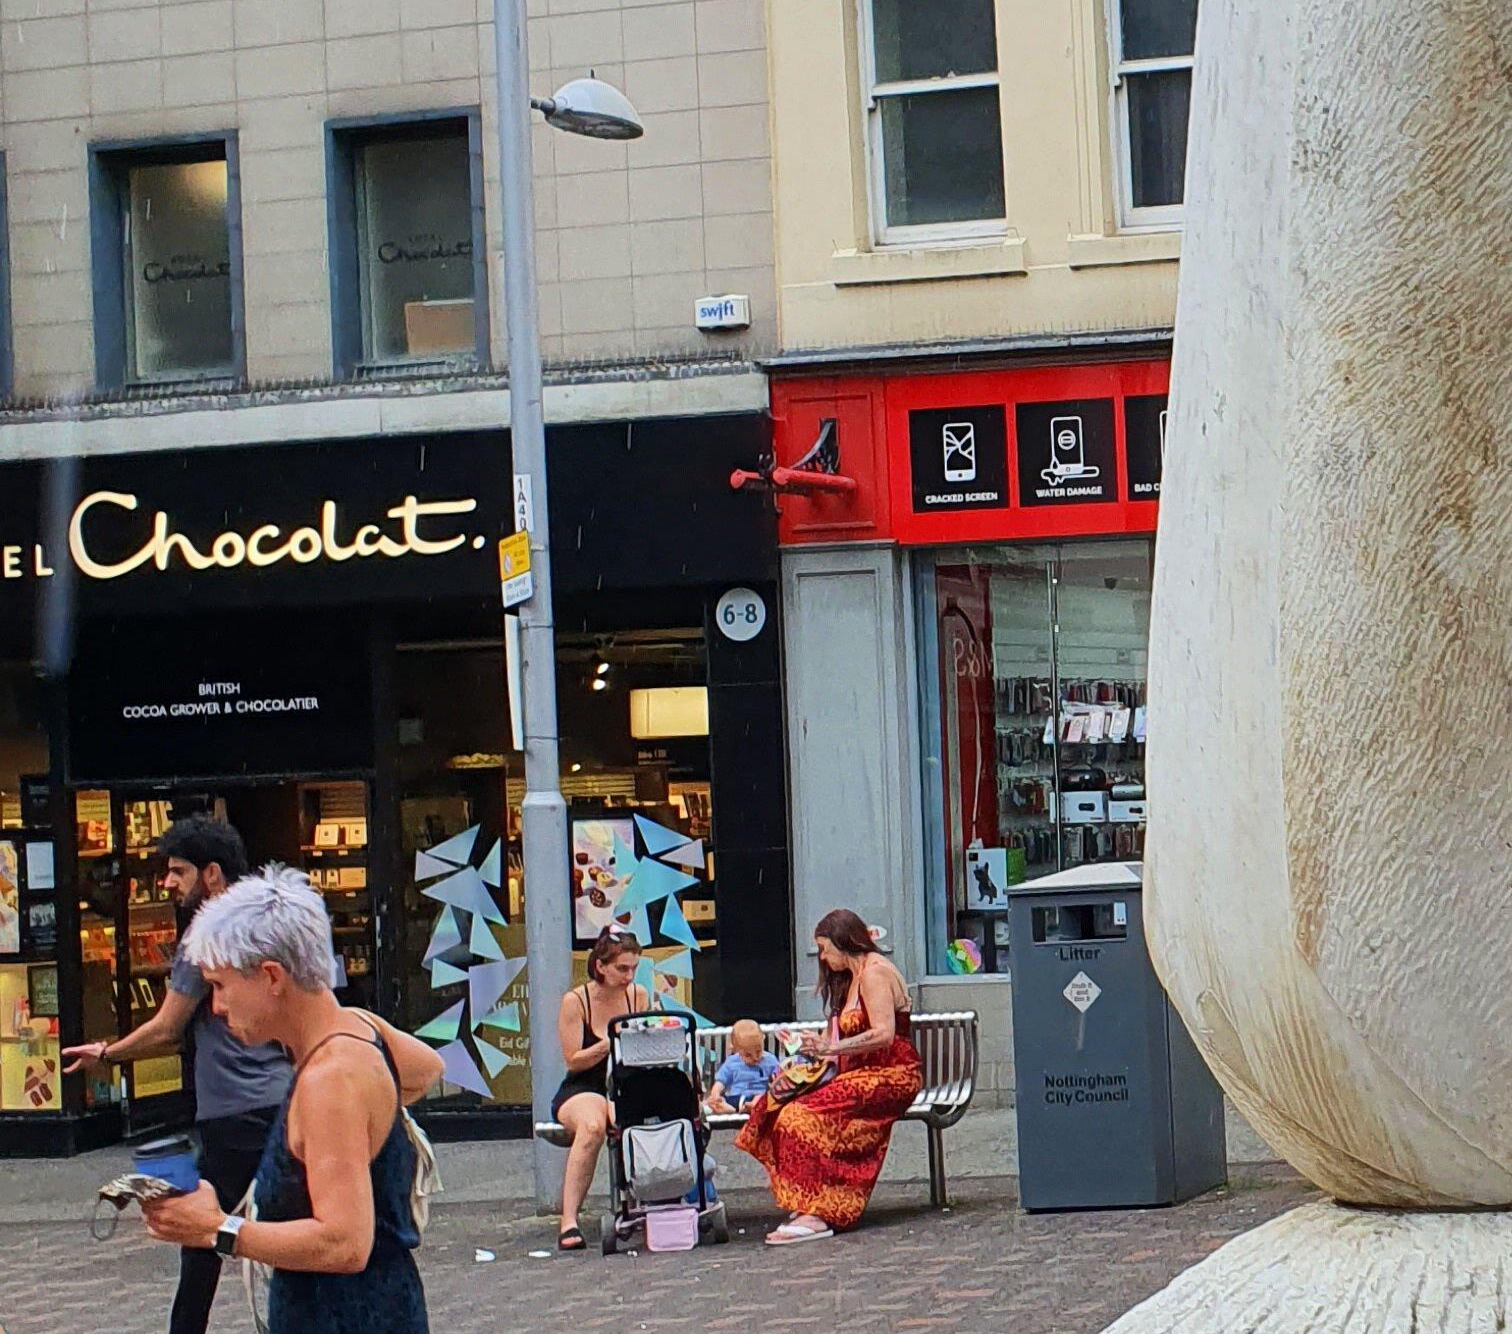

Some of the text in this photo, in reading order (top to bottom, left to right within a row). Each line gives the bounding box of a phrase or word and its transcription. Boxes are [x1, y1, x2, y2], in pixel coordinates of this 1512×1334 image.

[701, 300, 735, 321] swift
[1035, 486, 1102, 499] WATER DAMAGE
[1134, 483, 1153, 493] BAD
[925, 492, 998, 504] CRACKED SCREEN
[724, 603, 758, 625] 6-8
[199, 682, 241, 696] BRITISH
[123, 697, 319, 718] COCOA GROWER & CHOCOLATIER
[1060, 946, 1100, 961] Litter
[1045, 1073, 1127, 1089] Nottingham
[1045, 1088, 1129, 1106] City Council
